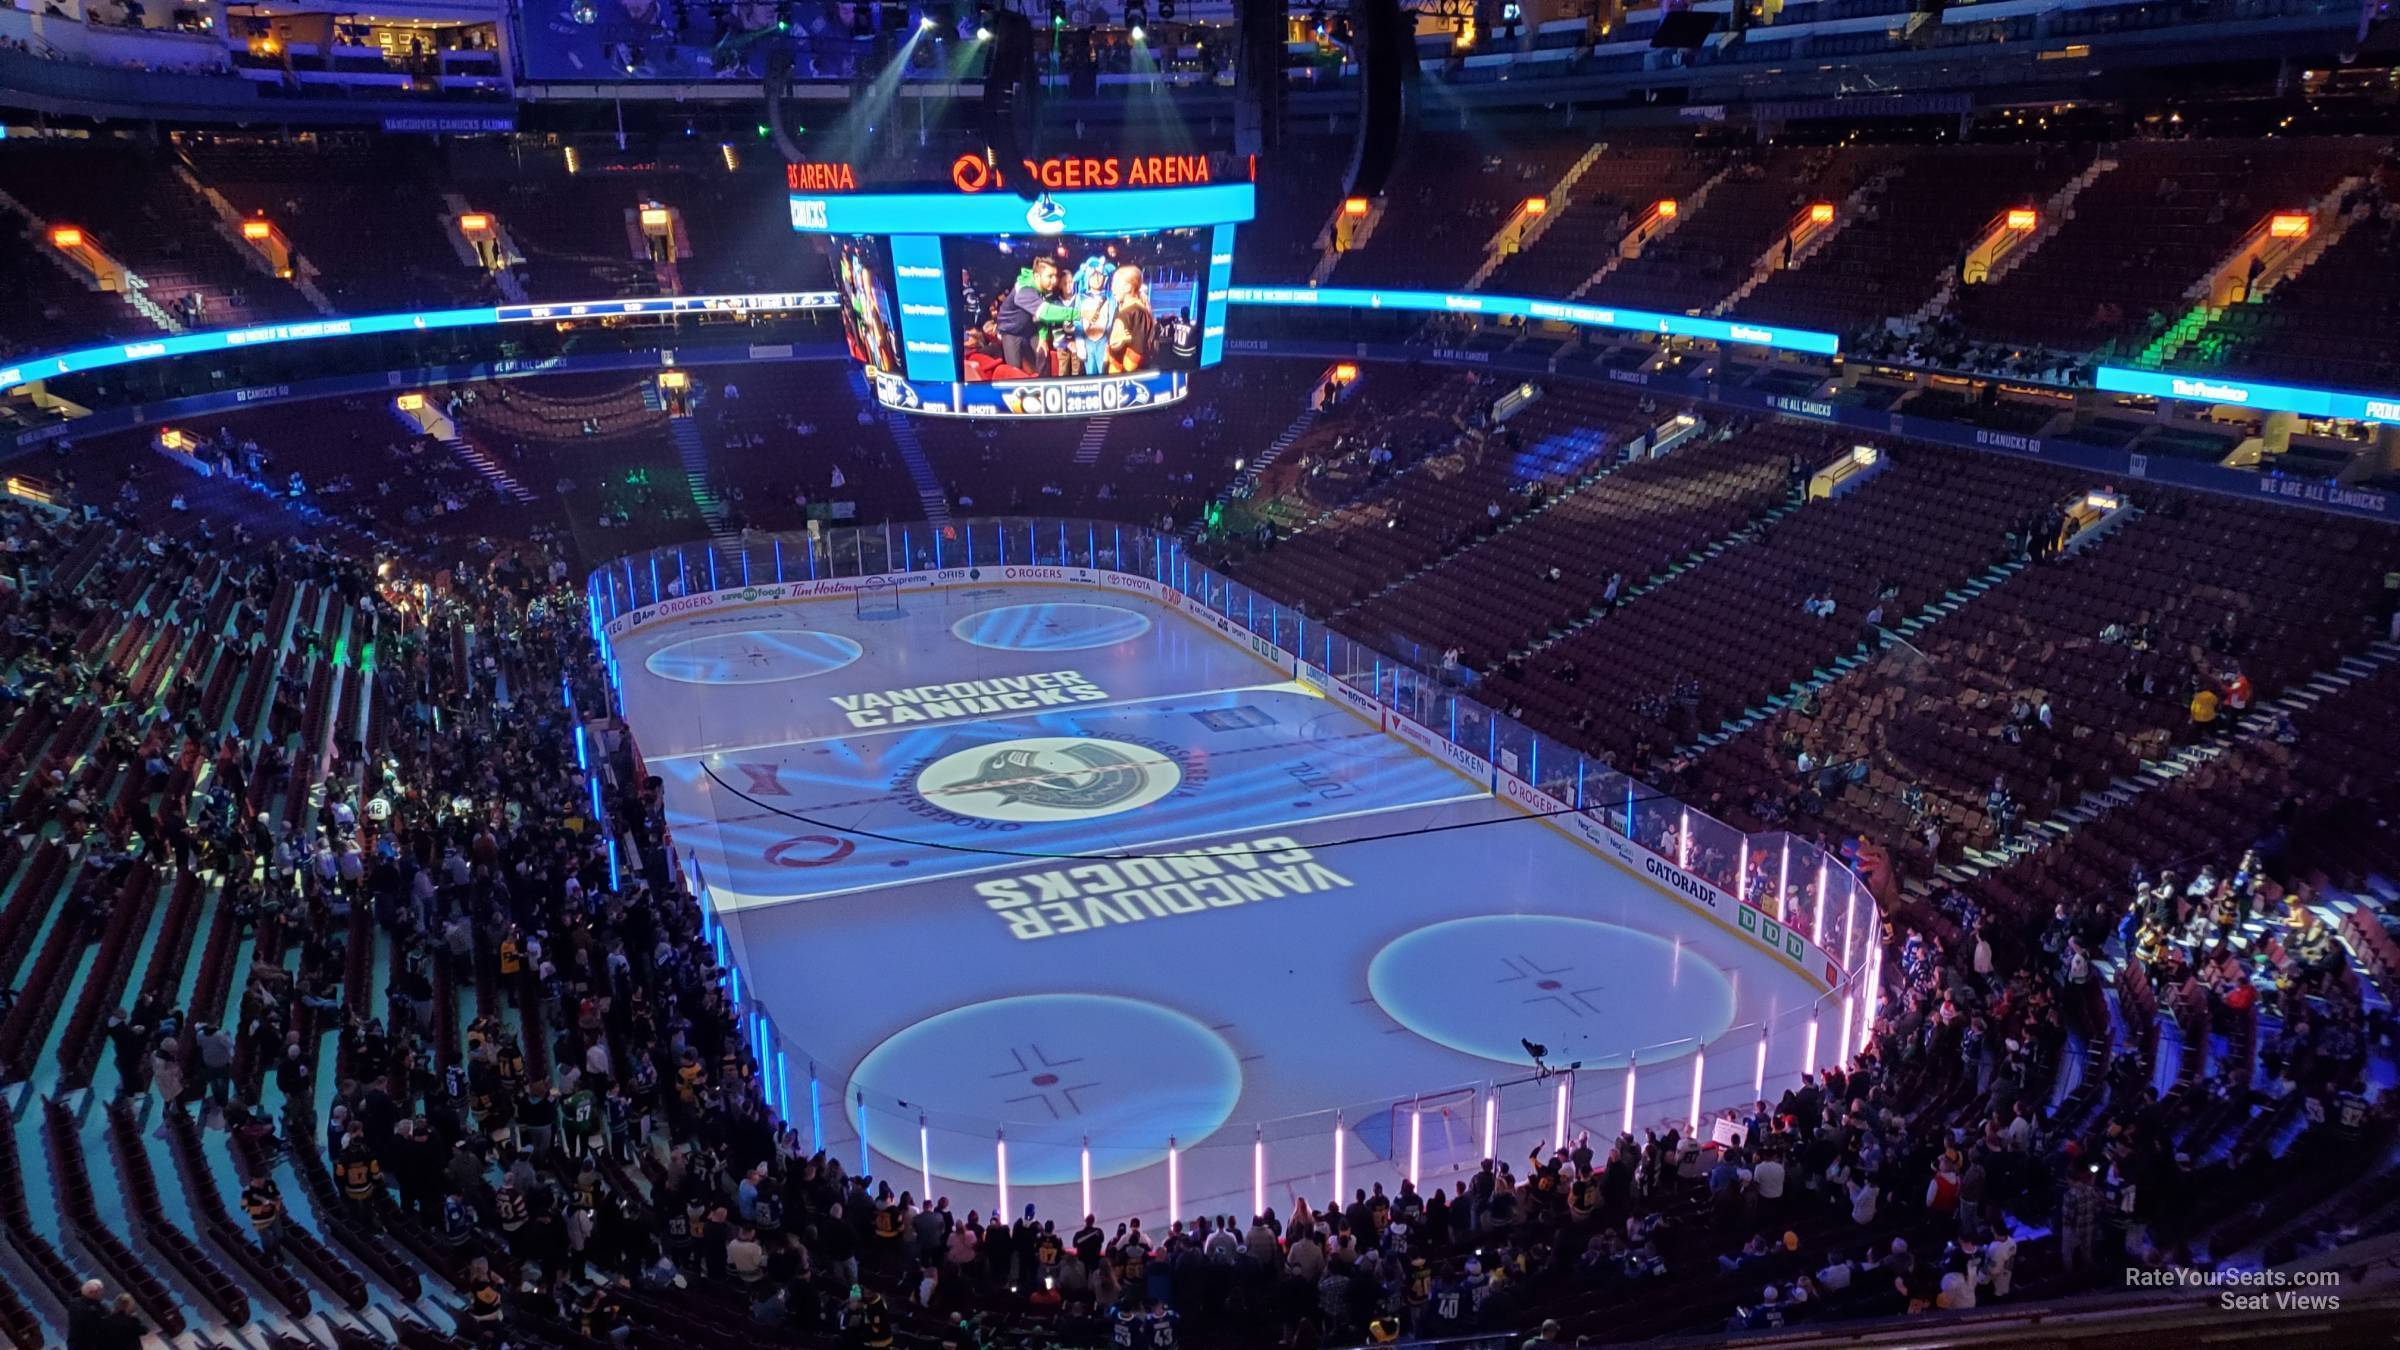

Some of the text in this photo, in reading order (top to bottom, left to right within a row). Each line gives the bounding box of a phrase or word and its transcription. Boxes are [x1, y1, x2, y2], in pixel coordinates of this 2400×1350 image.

[385, 119, 513, 130] VANCOUVER CANUCKS ALUMNI
[799, 163, 855, 190] ARENA
[1128, 154, 1209, 185] ARENA
[1045, 386, 1061, 412] 0
[1102, 383, 1117, 409] 0
[1777, 397, 1789, 409] ARE
[1790, 399, 1801, 411] ALL
[1802, 401, 1832, 417] CANUCKS
[1976, 430, 2041, 453] GO CANUCKS GO
[2260, 477, 2385, 512] WE ARE ALL CANUCKS
[888, 574, 927, 586] Supreme
[937, 569, 965, 580] ORIS
[1019, 568, 1062, 579] ROGERS
[1122, 577, 1150, 590] TOYOTA
[790, 583, 812, 597] Tim
[671, 595, 713, 612] ROGERS
[830, 670, 1089, 711] VANCOUVER
[1348, 690, 1367, 706] BOYD
[845, 683, 1110, 728] CANUCKS
[1448, 742, 1484, 776] FASKEN
[1519, 786, 1559, 818] ROGERS
[974, 836, 1315, 910] CANUCKS
[1646, 857, 1717, 908] GATORADE
[1001, 862, 1355, 941] VANCOUVER
[1438, 1299, 1459, 1319] 40
